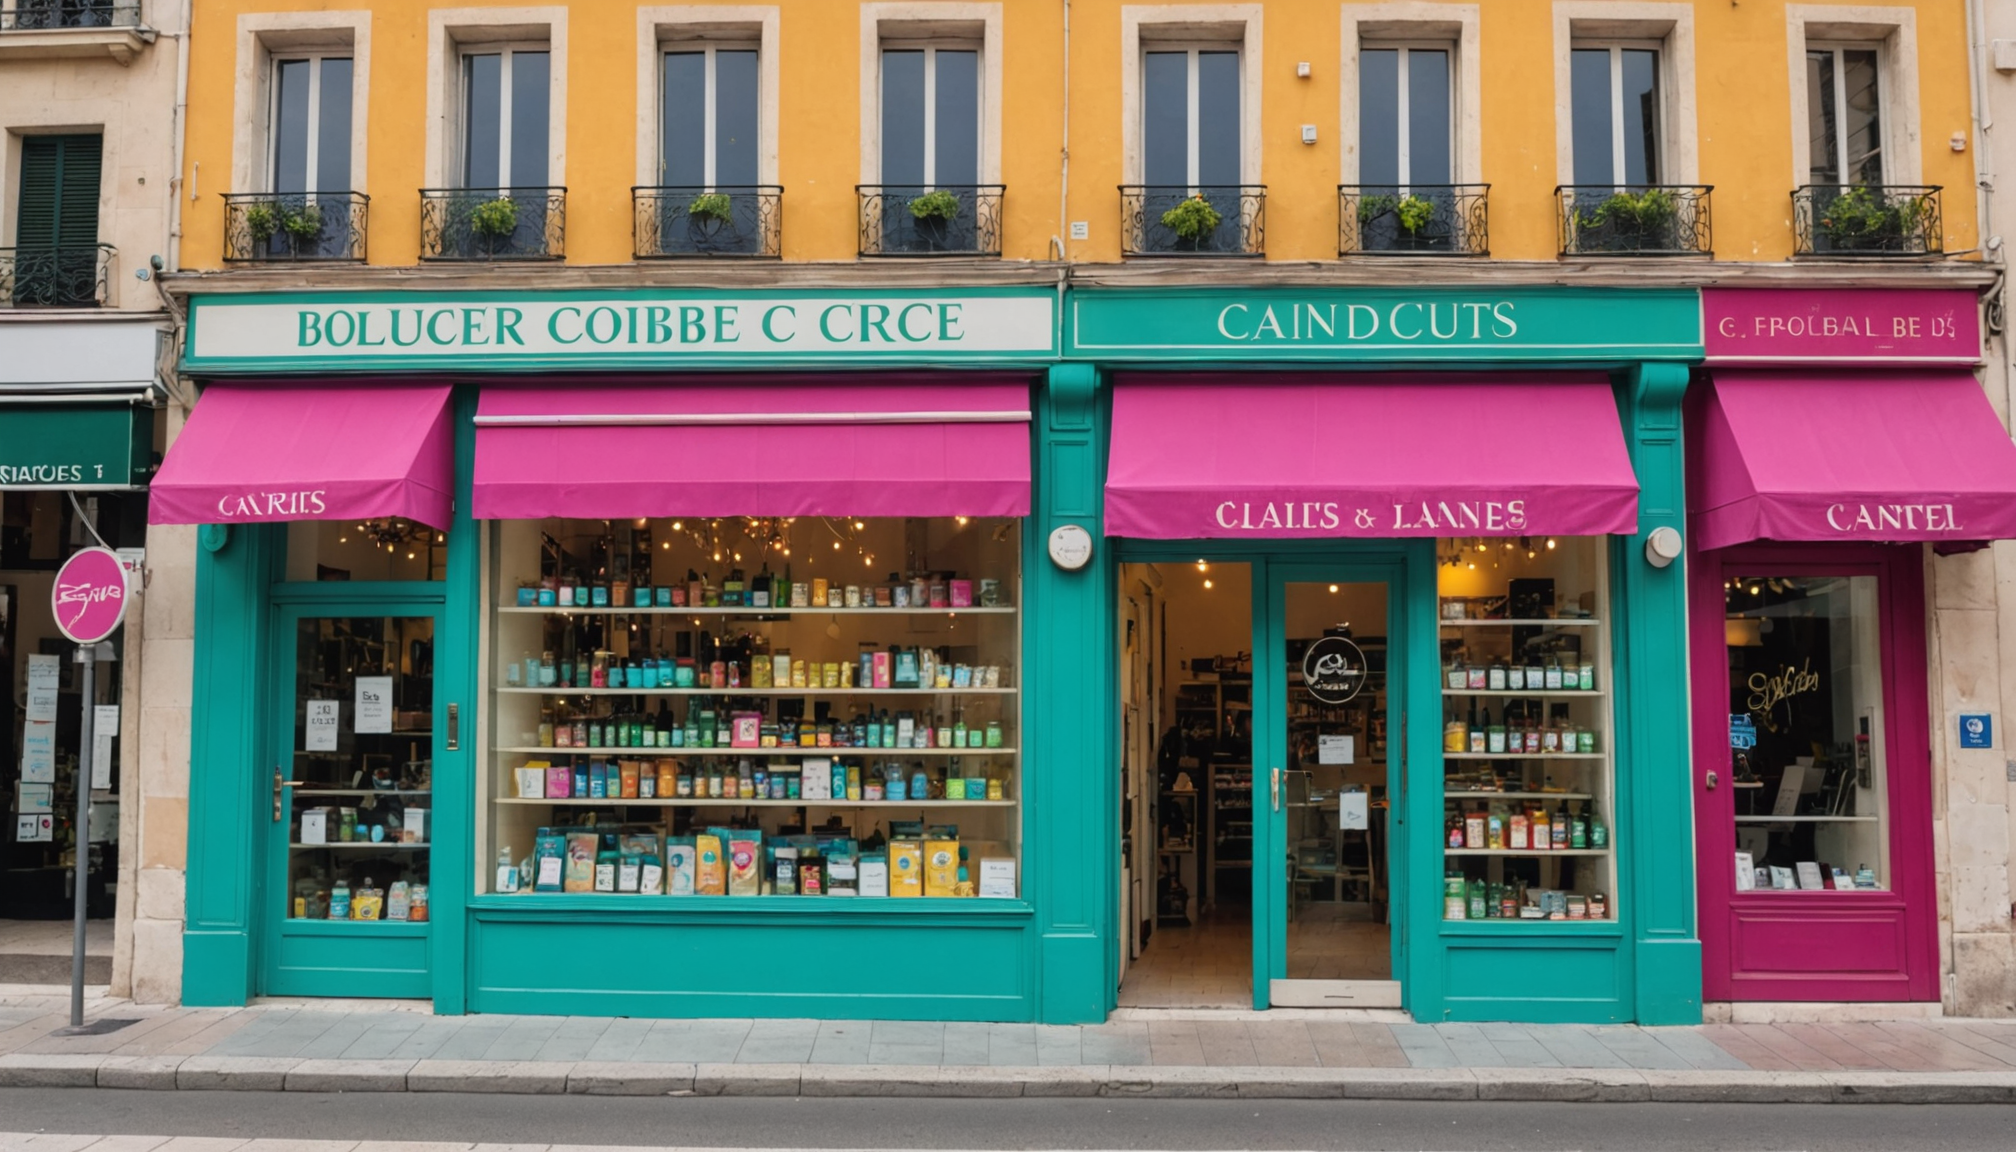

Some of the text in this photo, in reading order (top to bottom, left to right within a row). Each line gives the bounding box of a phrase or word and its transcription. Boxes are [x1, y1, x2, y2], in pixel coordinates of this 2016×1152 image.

[297, 302, 965, 348] BOLUCER COIBBE C CRCE
[1892, 316, 1921, 338] BE
[1354, 508, 1377, 529] &
[1826, 503, 1964, 532] CANTEL
